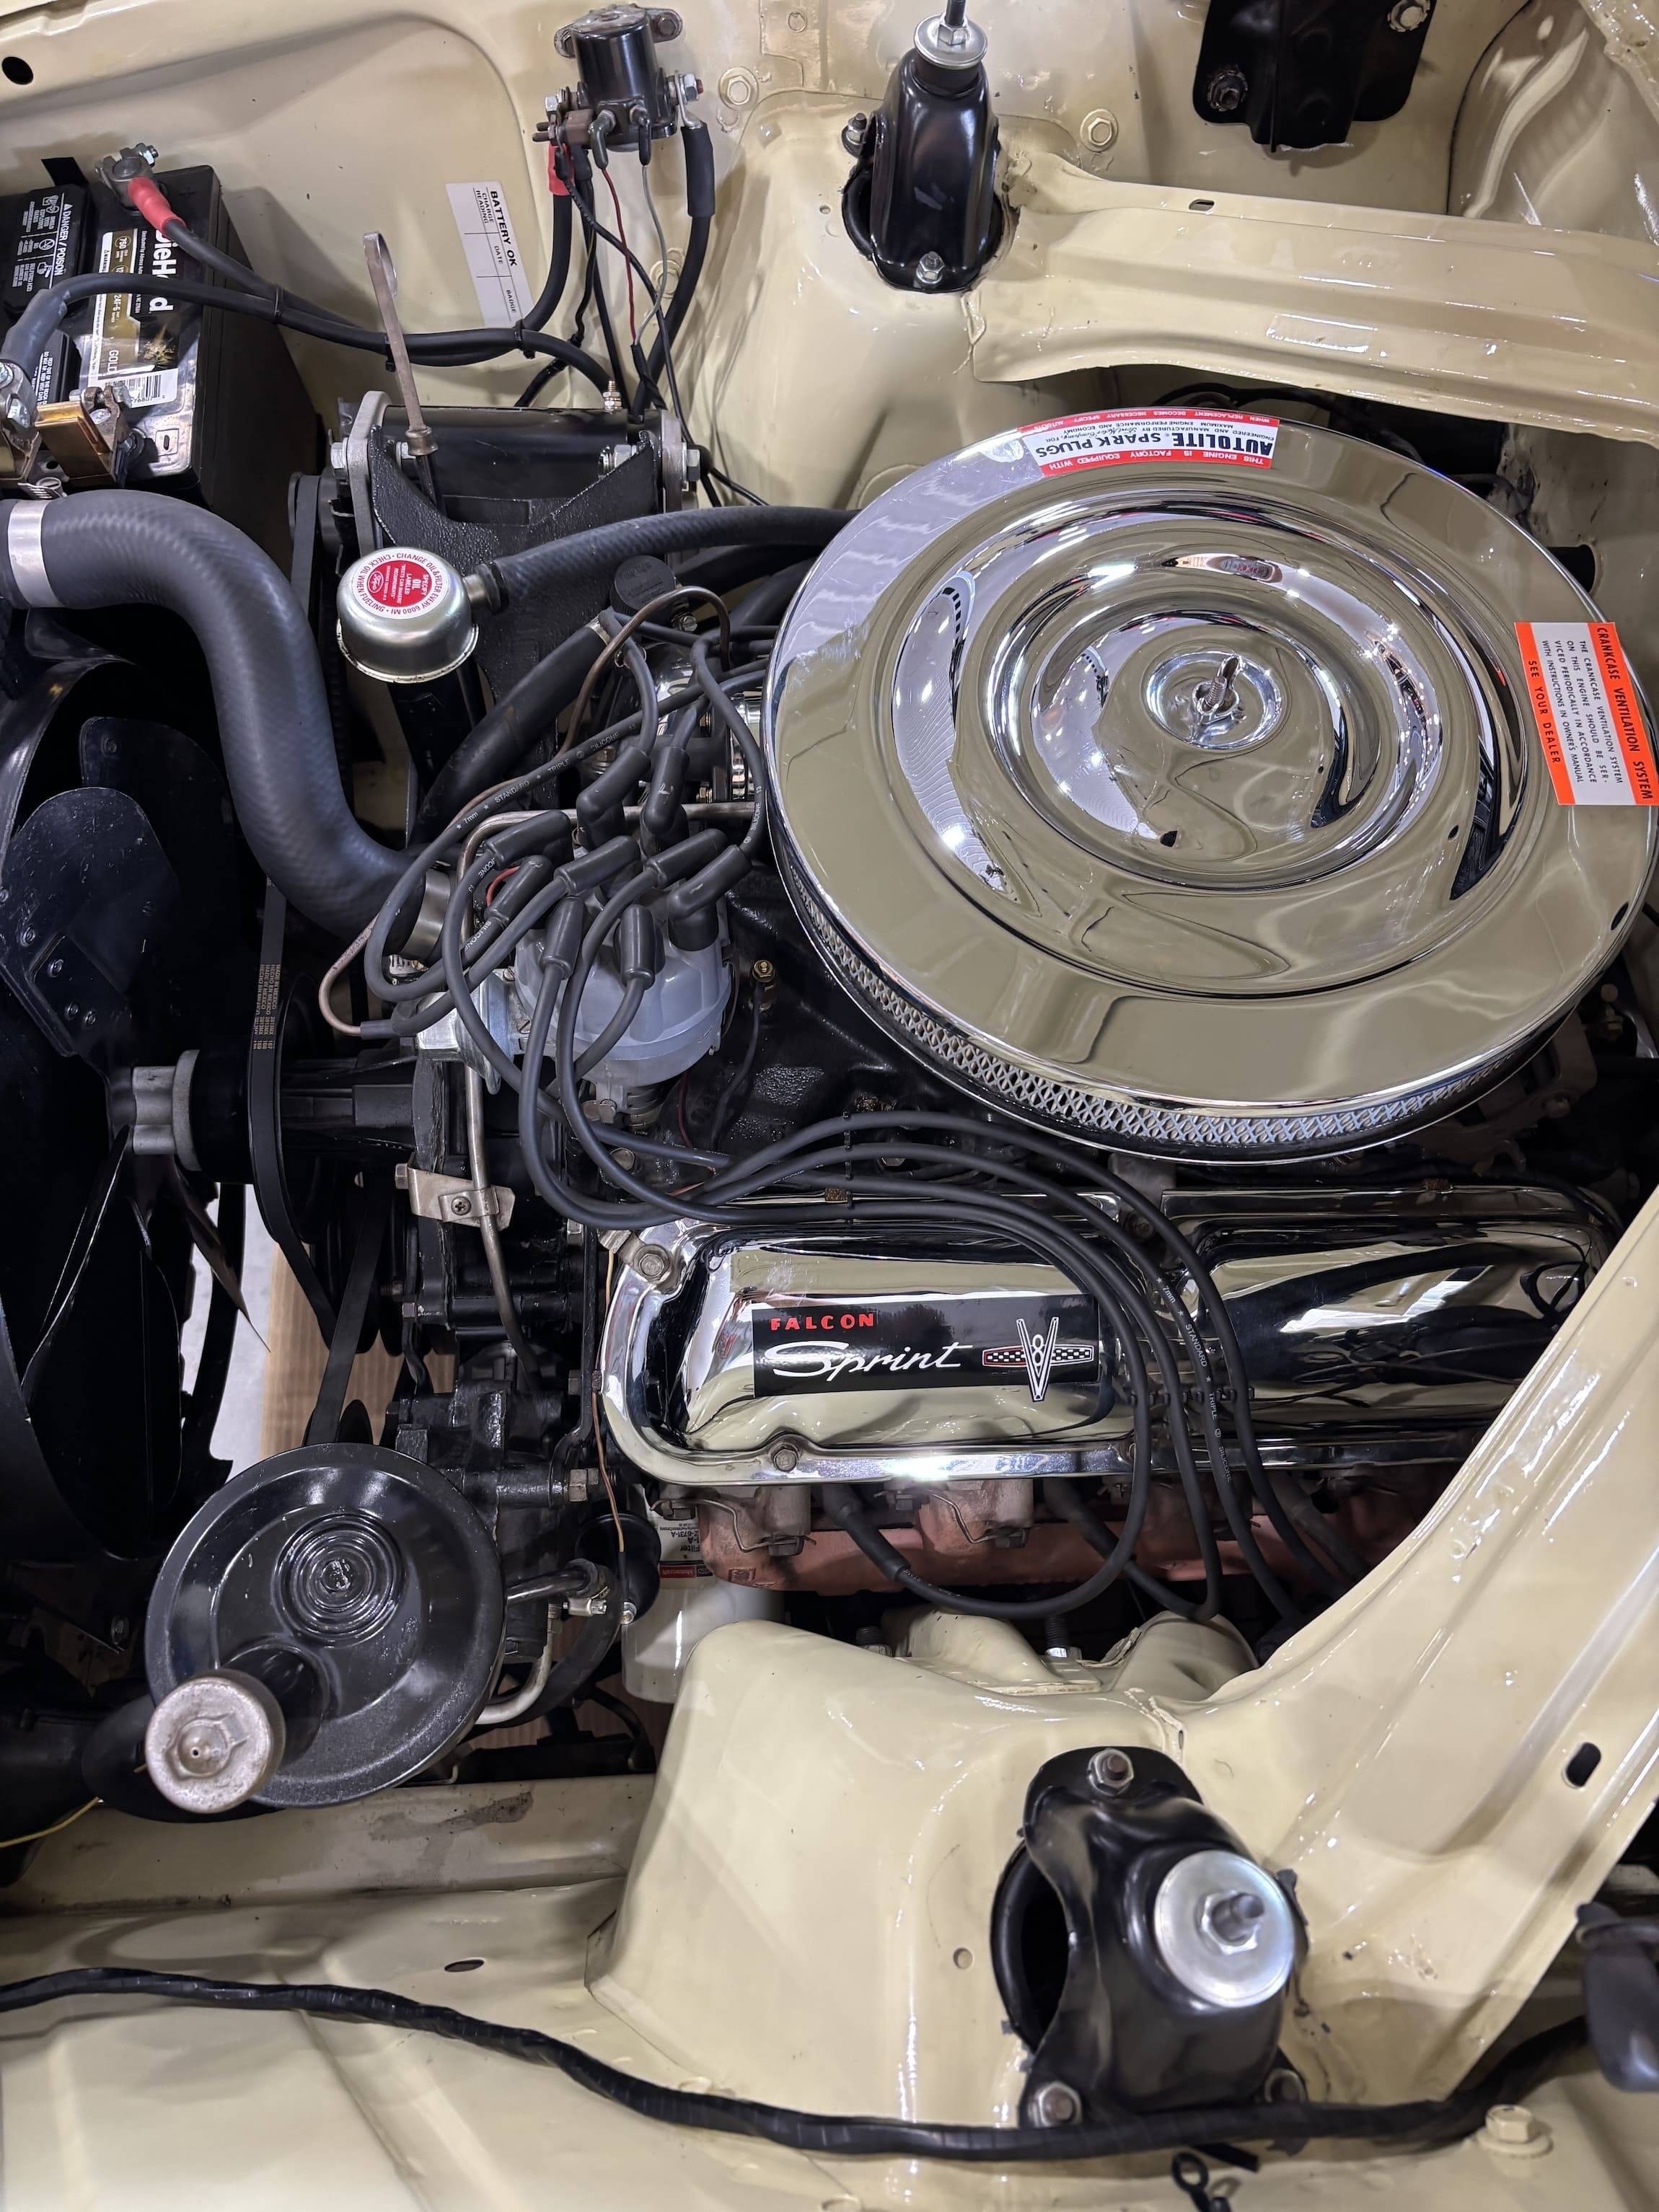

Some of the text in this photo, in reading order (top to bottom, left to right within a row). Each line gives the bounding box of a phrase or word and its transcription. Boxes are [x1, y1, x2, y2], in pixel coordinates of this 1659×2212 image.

[476, 190, 488, 224] READING
[482, 193, 494, 223] CHARGE
[59, 211, 71, 241] DANGER
[490, 191, 517, 266] BATTERY OK
[54, 248, 66, 276] POISON
[494, 246, 503, 264] DATE
[149, 230, 178, 312] ieHd
[506, 290, 516, 313] BADGE
[107, 350, 119, 372] GOLD
[1194, 411, 1244, 420] REPLACEMENT
[1035, 433, 1272, 457] AUTOLITE SPARK PLUGS
[1233, 430, 1274, 441] ENGINEERED
[1049, 460, 1073, 470] WITH
[1078, 453, 1119, 464] EQUIPPED
[1202, 451, 1237, 460] ENGINE
[1244, 456, 1263, 464] THIS
[369, 555, 390, 568] CHECK
[397, 553, 427, 564] CHANGE
[356, 575, 366, 593] WHEN
[412, 579, 421, 589] OIL
[360, 594, 385, 612] FUELING
[402, 605, 421, 614] 6000
[421, 593, 439, 609] EVERY
[1542, 640, 1552, 656] WITH
[1546, 661, 1565, 707] INSTRUCTIONS
[1528, 661, 1561, 763] SEE YOUR DEALER
[1555, 640, 1566, 664] VICED
[1561, 666, 1580, 715] PERIODICALLY
[1578, 732, 1597, 783] ACCORDANCE
[1567, 641, 1575, 651] ON
[1571, 656, 1580, 671] THIS
[1577, 679, 1590, 707] ENGINE
[1585, 714, 1600, 744] SHOULD
[1598, 765, 1607, 783] SER-
[1579, 641, 1623, 784] THE CRANKCASE VENTILATION SYSTEM
[1597, 627, 1653, 799] CRANKCASE VENTILATION SYSTEM
[1562, 722, 1577, 750] OWNER'S
[464, 732, 618, 824] 7mm STANDARD TRIPLE SILICONE
[1571, 754, 1584, 783] MANUAL
[750, 803, 762, 831] SILICONE
[478, 858, 495, 878] ICONE
[464, 920, 492, 952] SILICONE
[770, 1313, 875, 1331] FALCON
[764, 1341, 973, 1381] Sprint
[1162, 1285, 1232, 1483] 7mm STANDARD TRIPLE SILICONE
